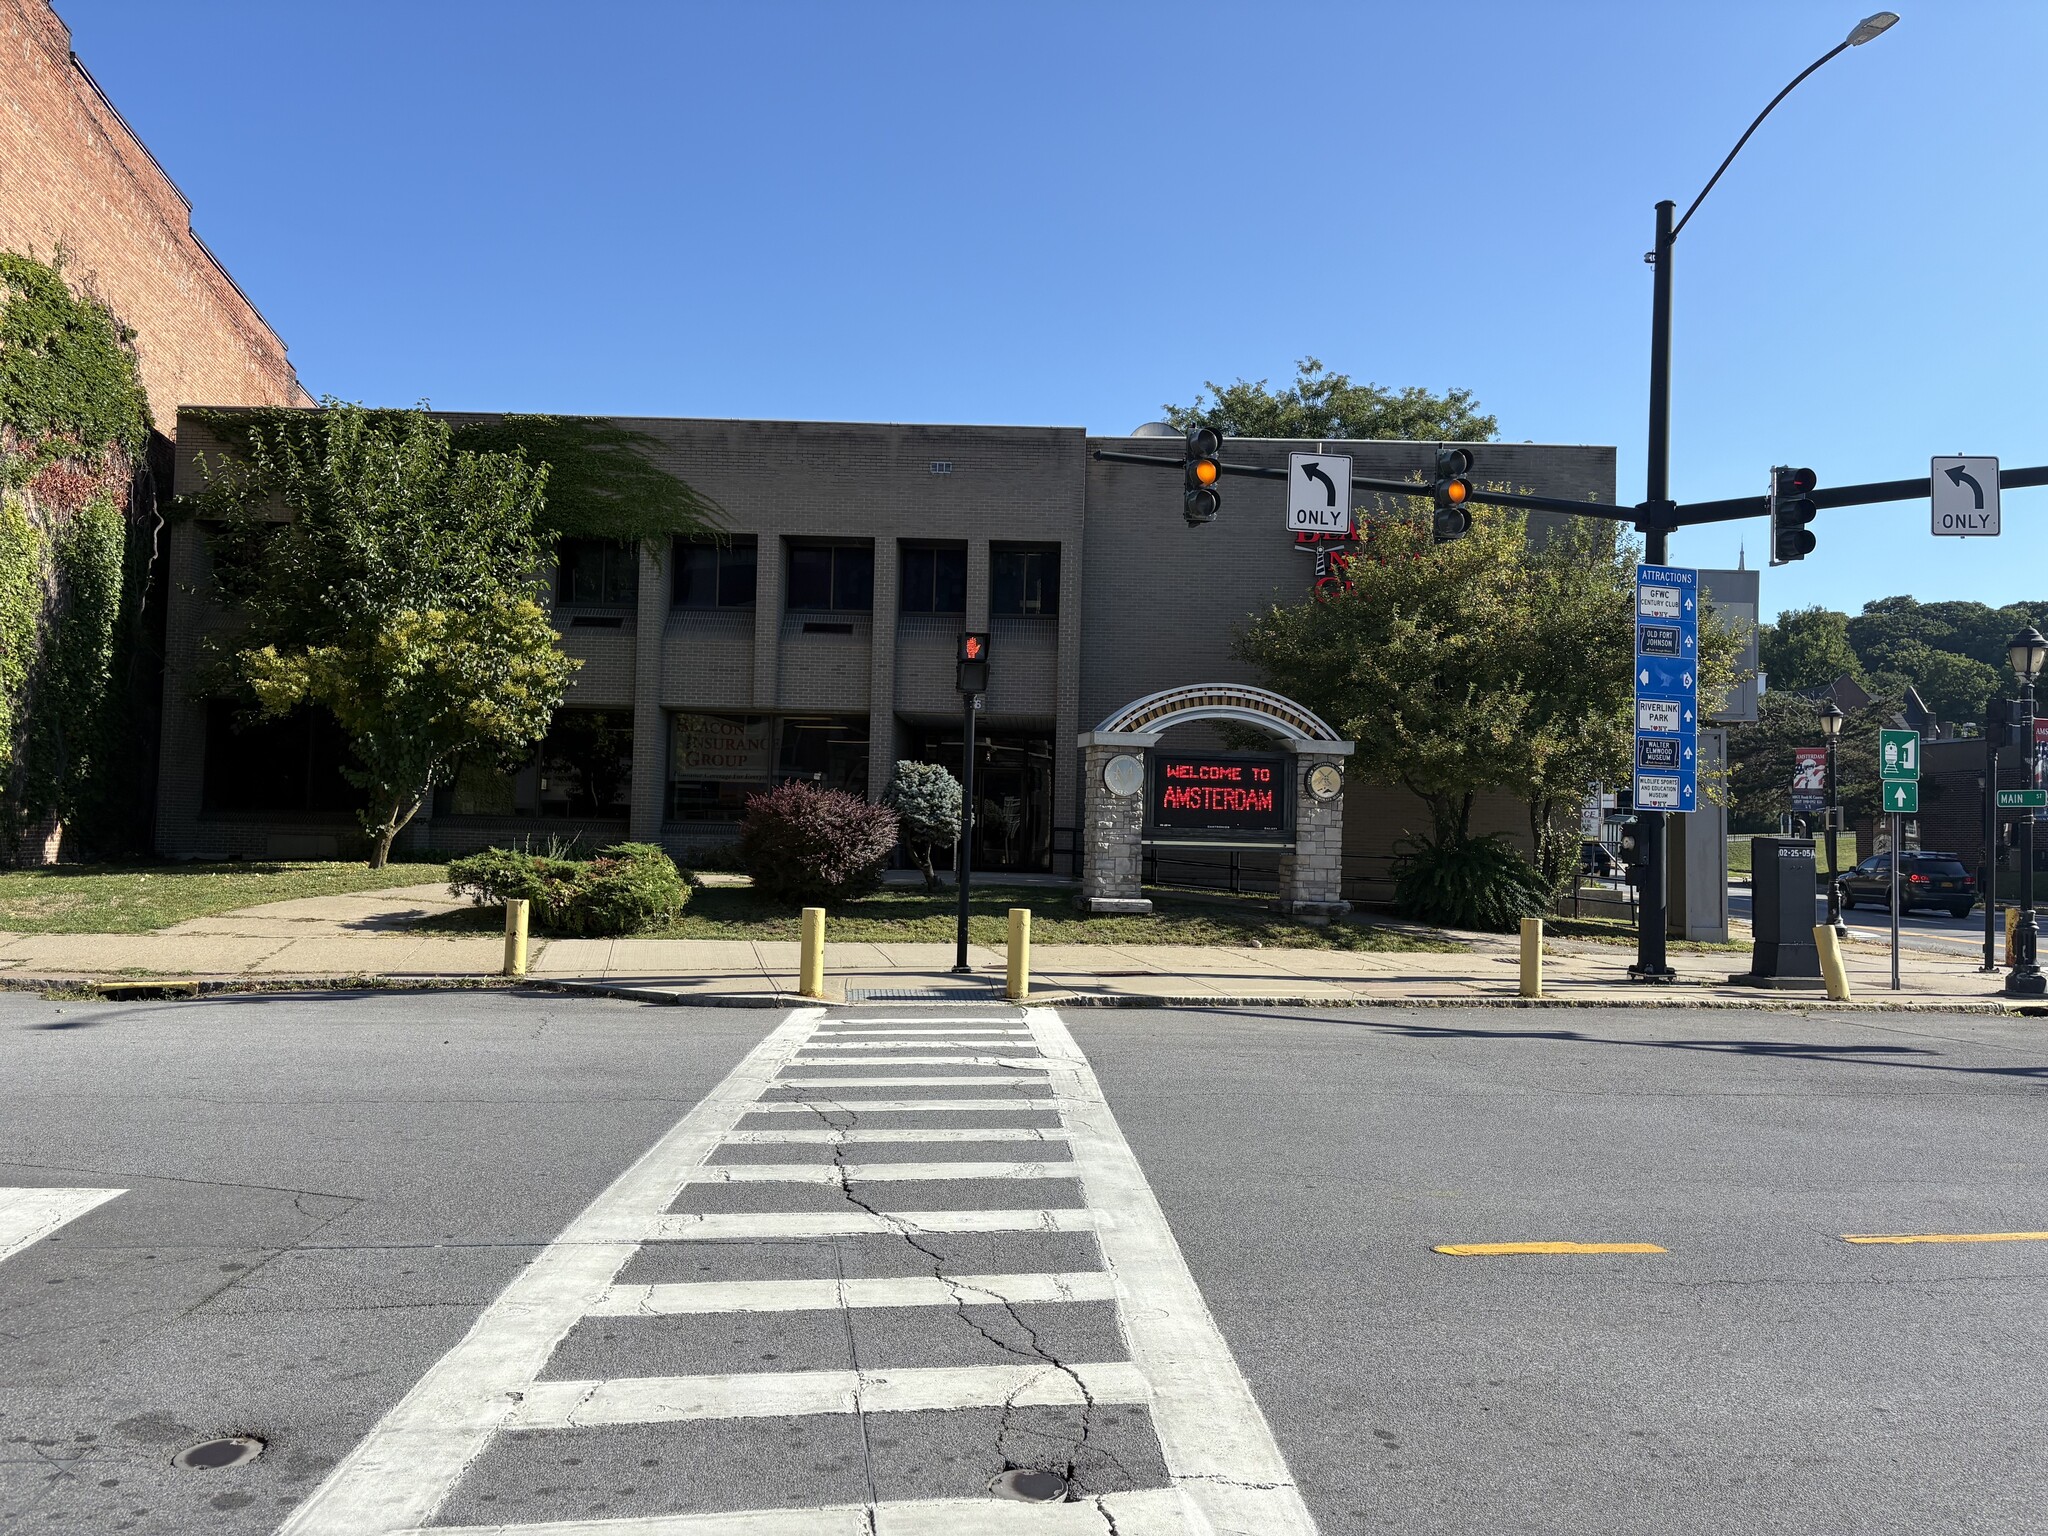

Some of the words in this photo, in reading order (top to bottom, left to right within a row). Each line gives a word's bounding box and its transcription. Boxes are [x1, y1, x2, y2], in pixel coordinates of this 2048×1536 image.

[1296, 509, 1341, 526] ONLY
[1942, 513, 1990, 529] ONLY
[1642, 570, 1692, 583] ATTRACTIONS
[1650, 590, 1669, 598] GFWC
[1646, 630, 1658, 638] OLD
[1659, 631, 1673, 639] FORT
[1646, 639, 1673, 647] JOHNSON
[1684, 675, 1689, 685] 6
[1640, 703, 1678, 713] RIVERLINK
[1649, 713, 1669, 722] PARK
[686, 751, 748, 767] GROUP
[1166, 764, 1241, 780] WELCOME
[1251, 767, 1270, 782] TO
[1163, 785, 1272, 811] AMSTERDAM
[2000, 794, 2023, 804] MAIN
